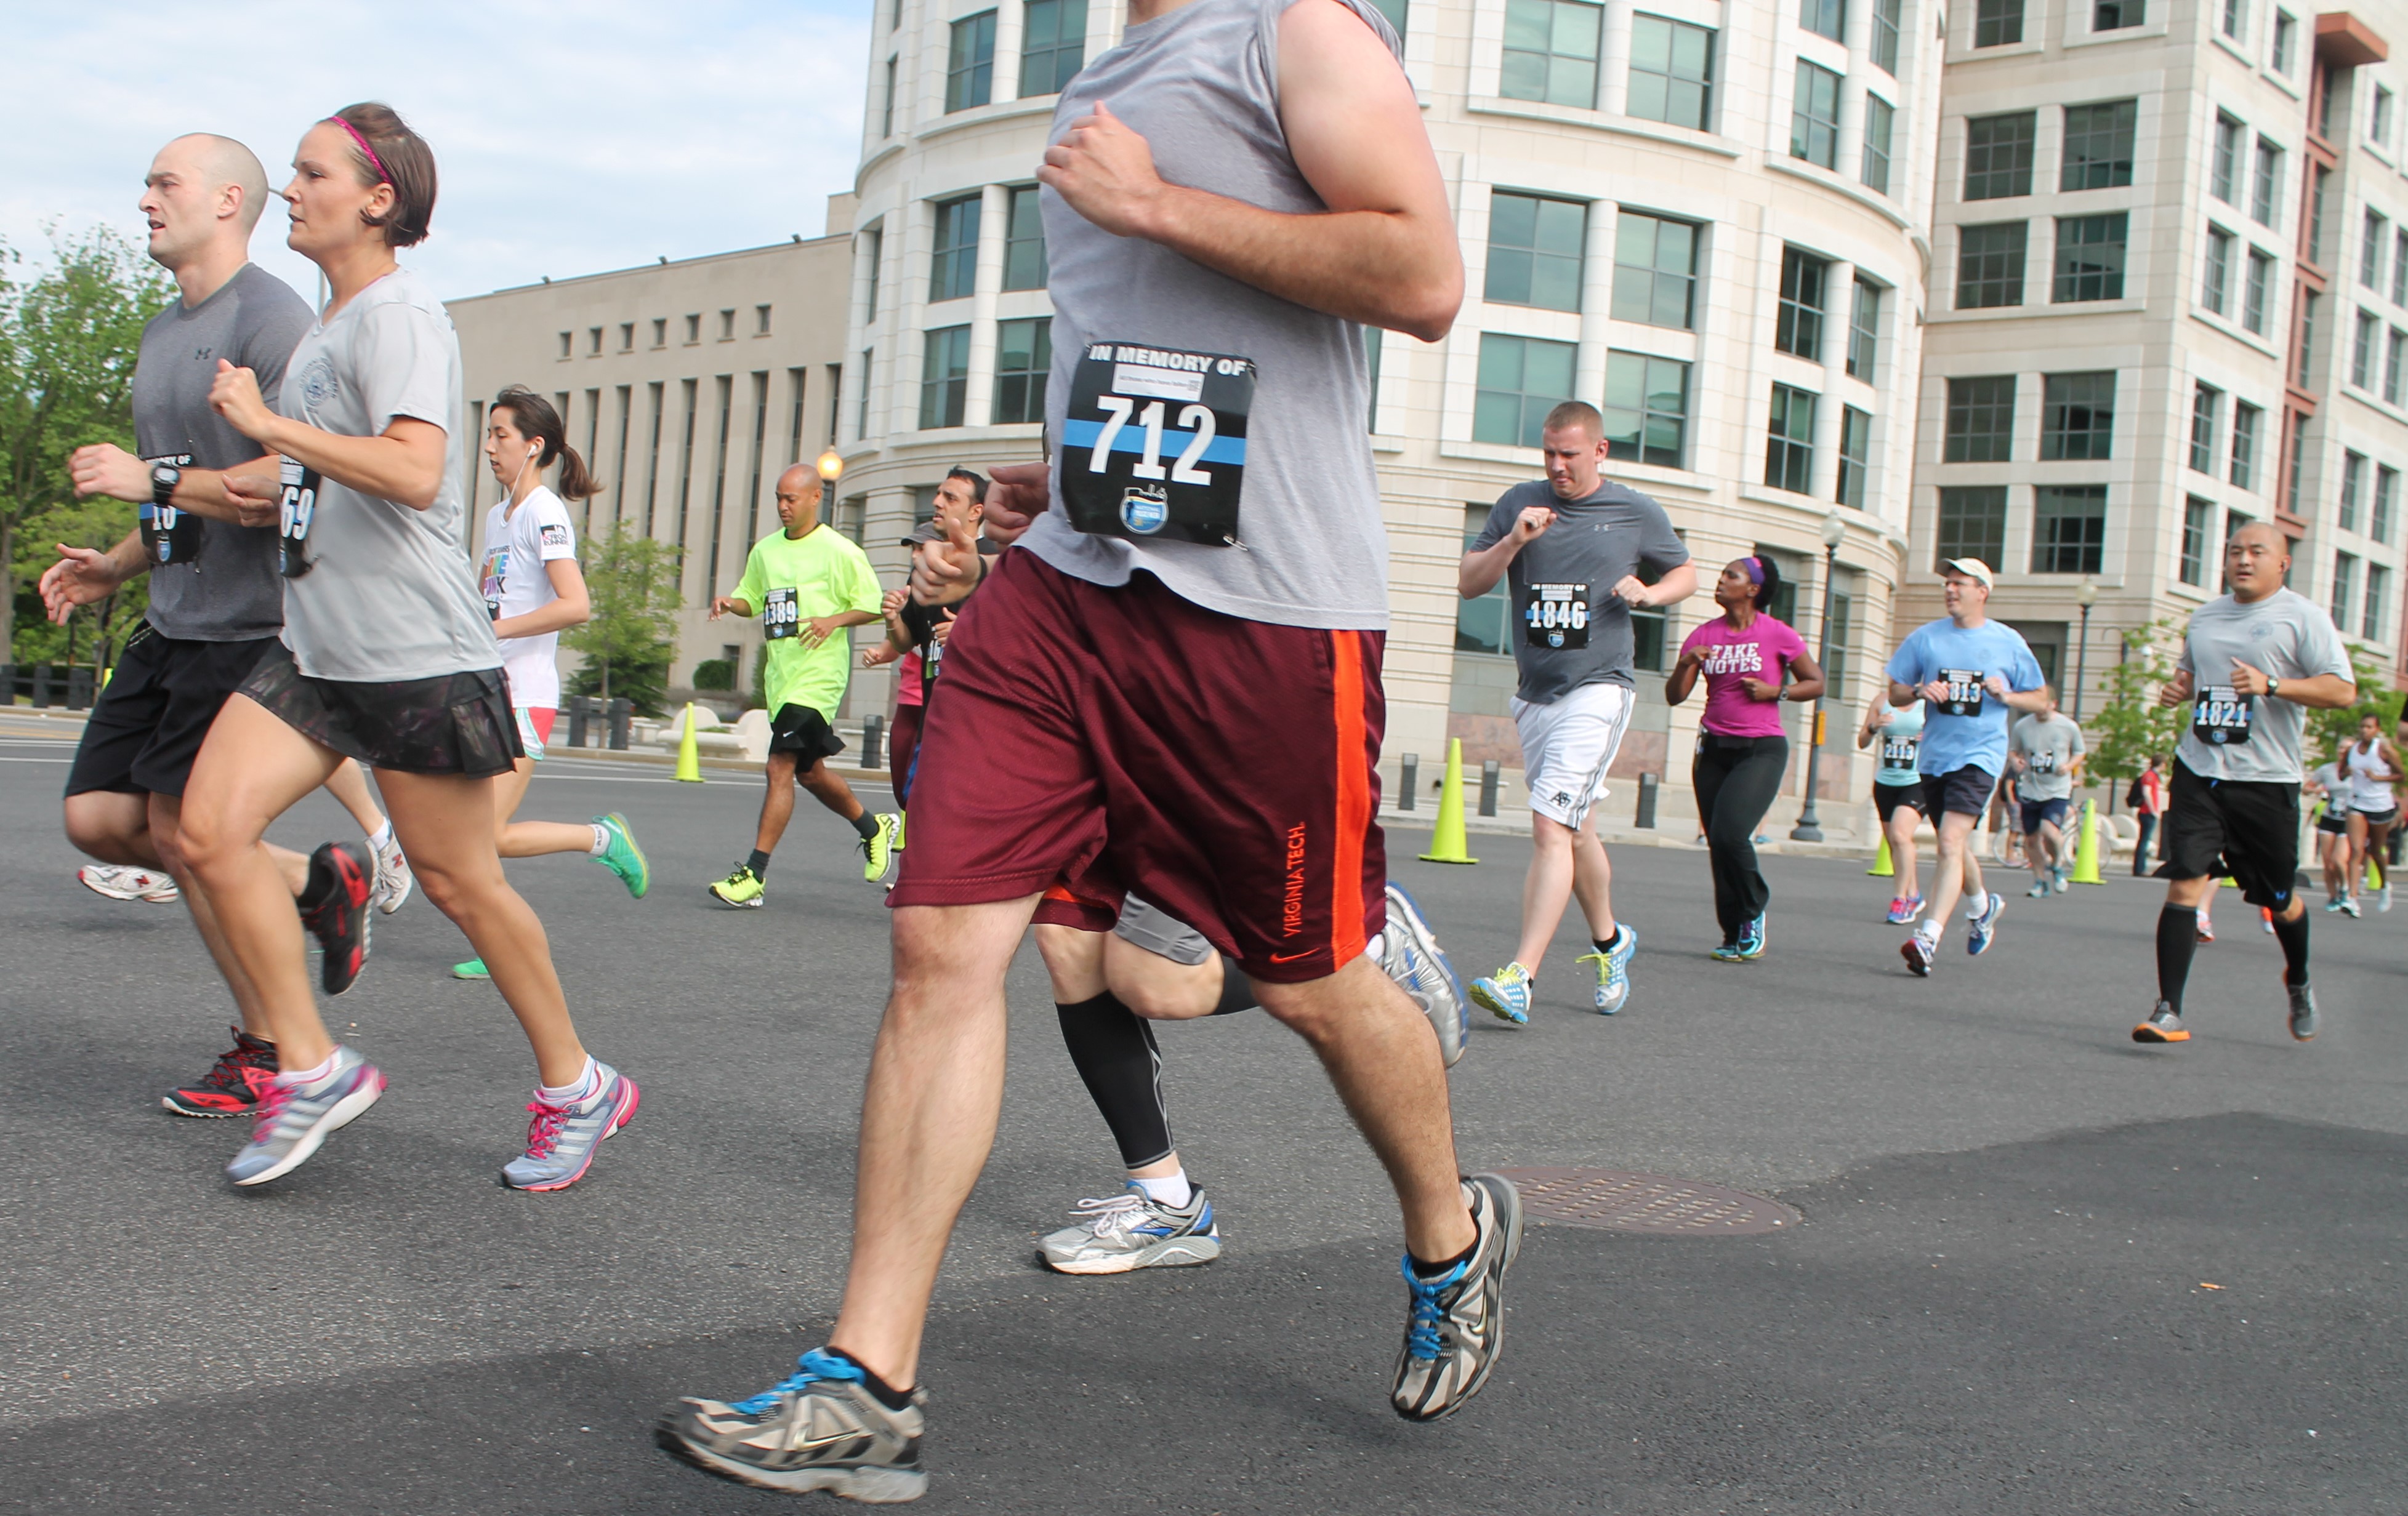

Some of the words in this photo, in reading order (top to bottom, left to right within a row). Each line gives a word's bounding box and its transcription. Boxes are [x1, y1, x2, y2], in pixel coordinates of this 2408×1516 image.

[1089, 345, 1113, 361] IN
[1116, 345, 1214, 373] MEMORY
[1216, 358, 1248, 376] OF
[1089, 395, 1217, 486] 712
[280, 485, 315, 540] 69
[1574, 584, 1586, 592] OF
[765, 600, 796, 625] 1389
[1530, 601, 1586, 630] 1846
[1712, 643, 1759, 659] TAKE
[1704, 657, 1762, 674] NOTES
[1942, 680, 1982, 703] 813
[2196, 701, 2247, 728] 1821
[1885, 744, 1915, 760] 2113
[1286, 828, 1306, 870] TECH
[1283, 867, 1305, 937] VIRGINIA
